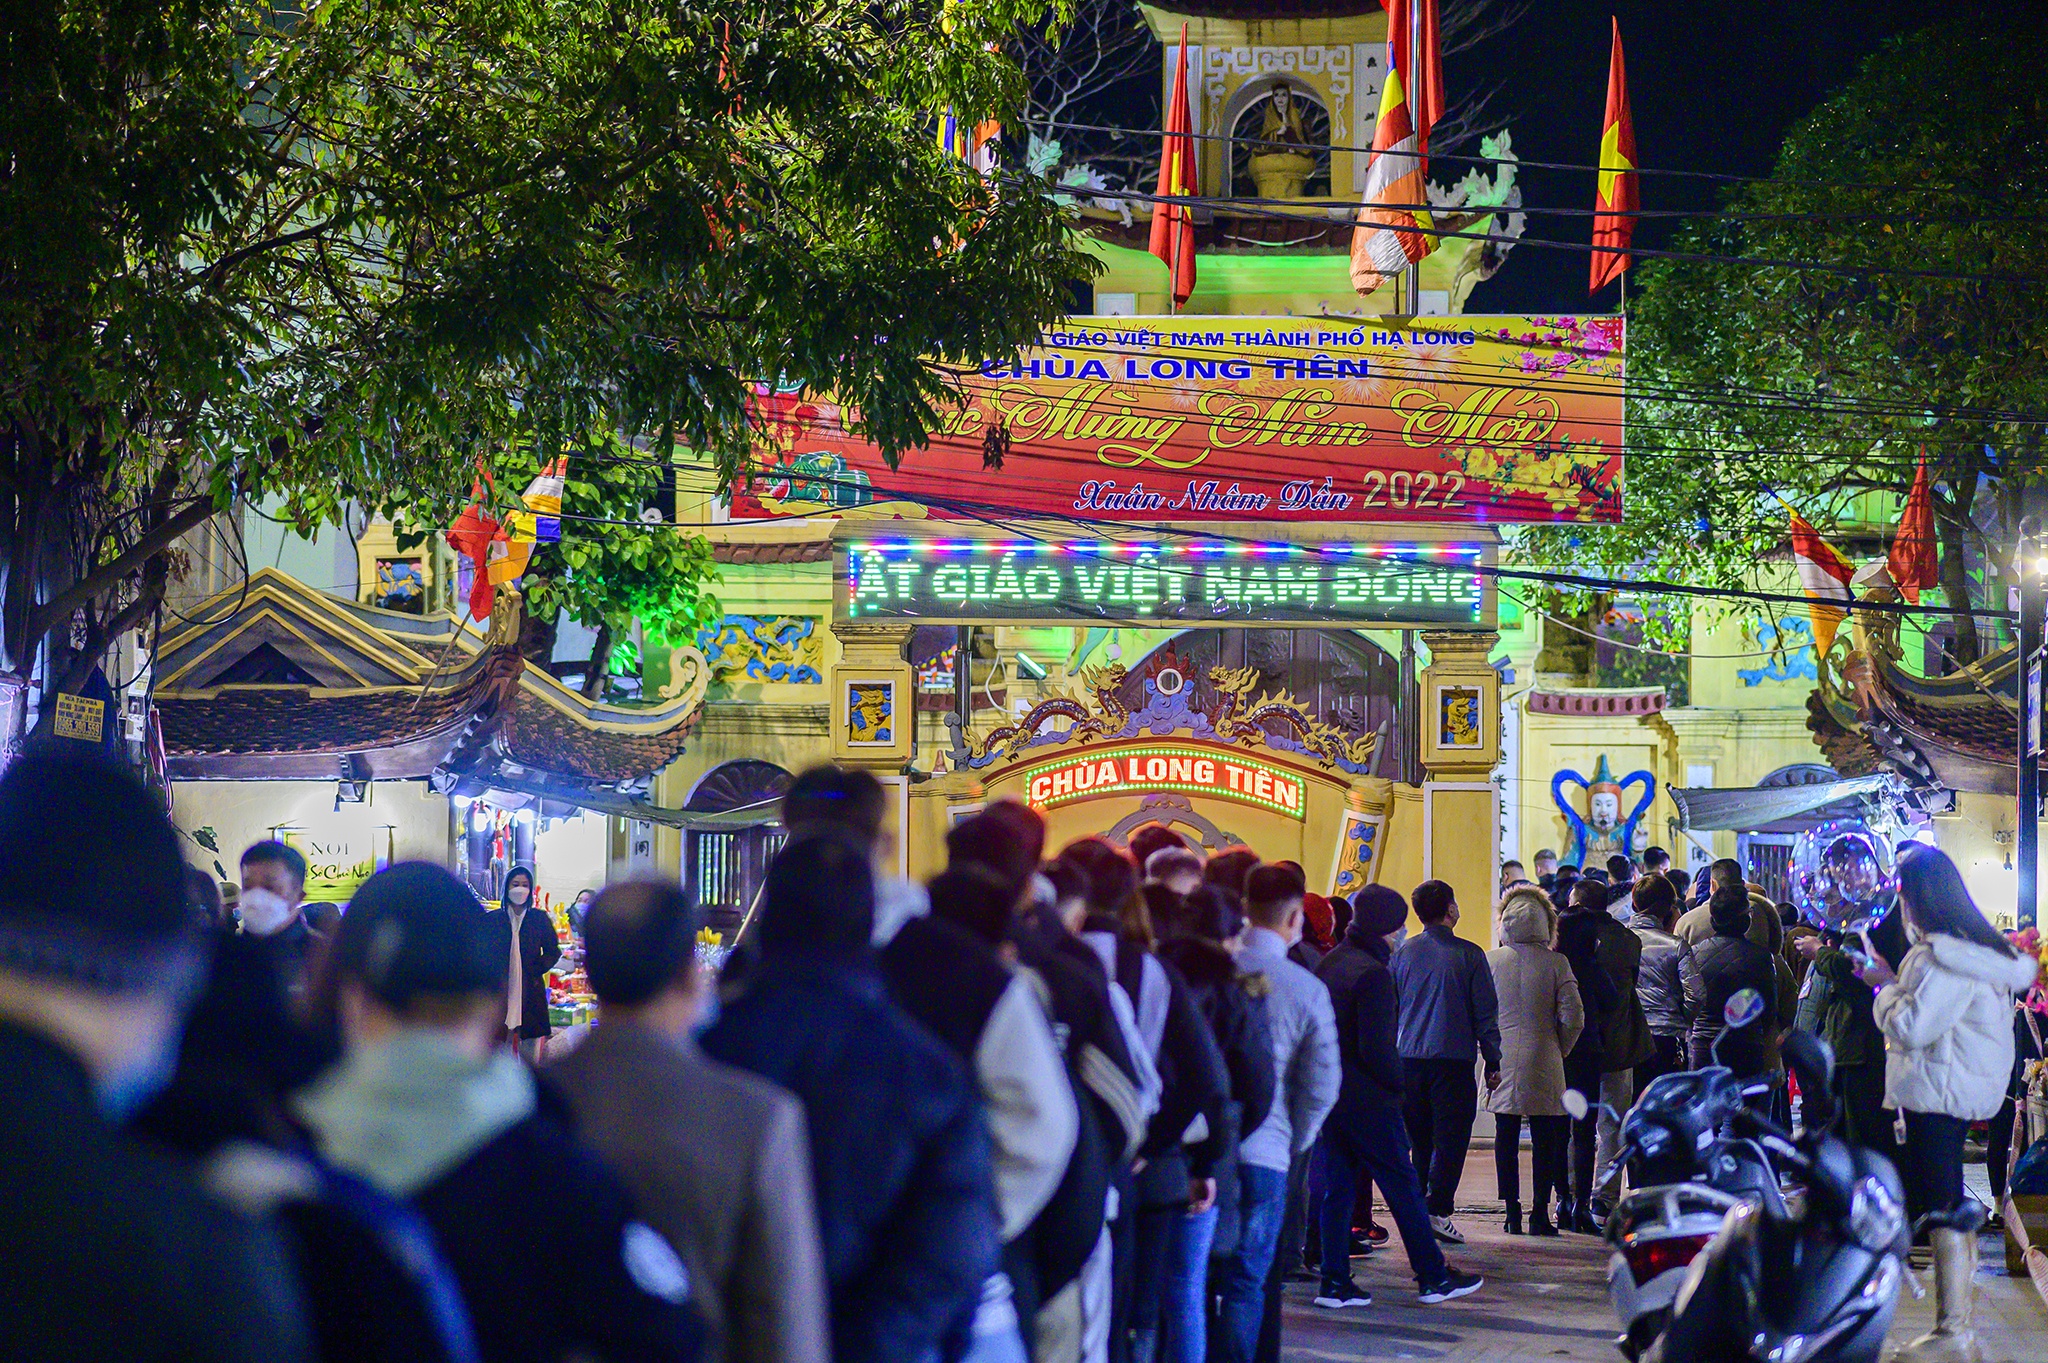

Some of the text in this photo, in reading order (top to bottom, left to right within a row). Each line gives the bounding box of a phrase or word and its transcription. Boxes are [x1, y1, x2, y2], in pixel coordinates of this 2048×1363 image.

[1051, 328, 1108, 347] GIÁO
[1115, 328, 1162, 350] VIỆT
[1171, 331, 1224, 346] NAM
[1232, 328, 1310, 346] THÀNH
[1318, 325, 1365, 346] PHỐ
[1372, 332, 1402, 350] HẠ
[1412, 331, 1475, 346] LONG
[980, 353, 1370, 380] CHÙA LONG TIÊN
[990, 382, 1211, 469] Mừng
[1197, 387, 1373, 449] Năm
[1390, 386, 1560, 449] Mới
[1072, 470, 1467, 511] Xuân Nhâm Dần 2022
[932, 551, 1061, 600] GIÁO
[1073, 552, 1192, 613] VIỆT
[1204, 567, 1319, 601] NAM
[1031, 758, 1298, 808] CHÙA LONG TIÊN
